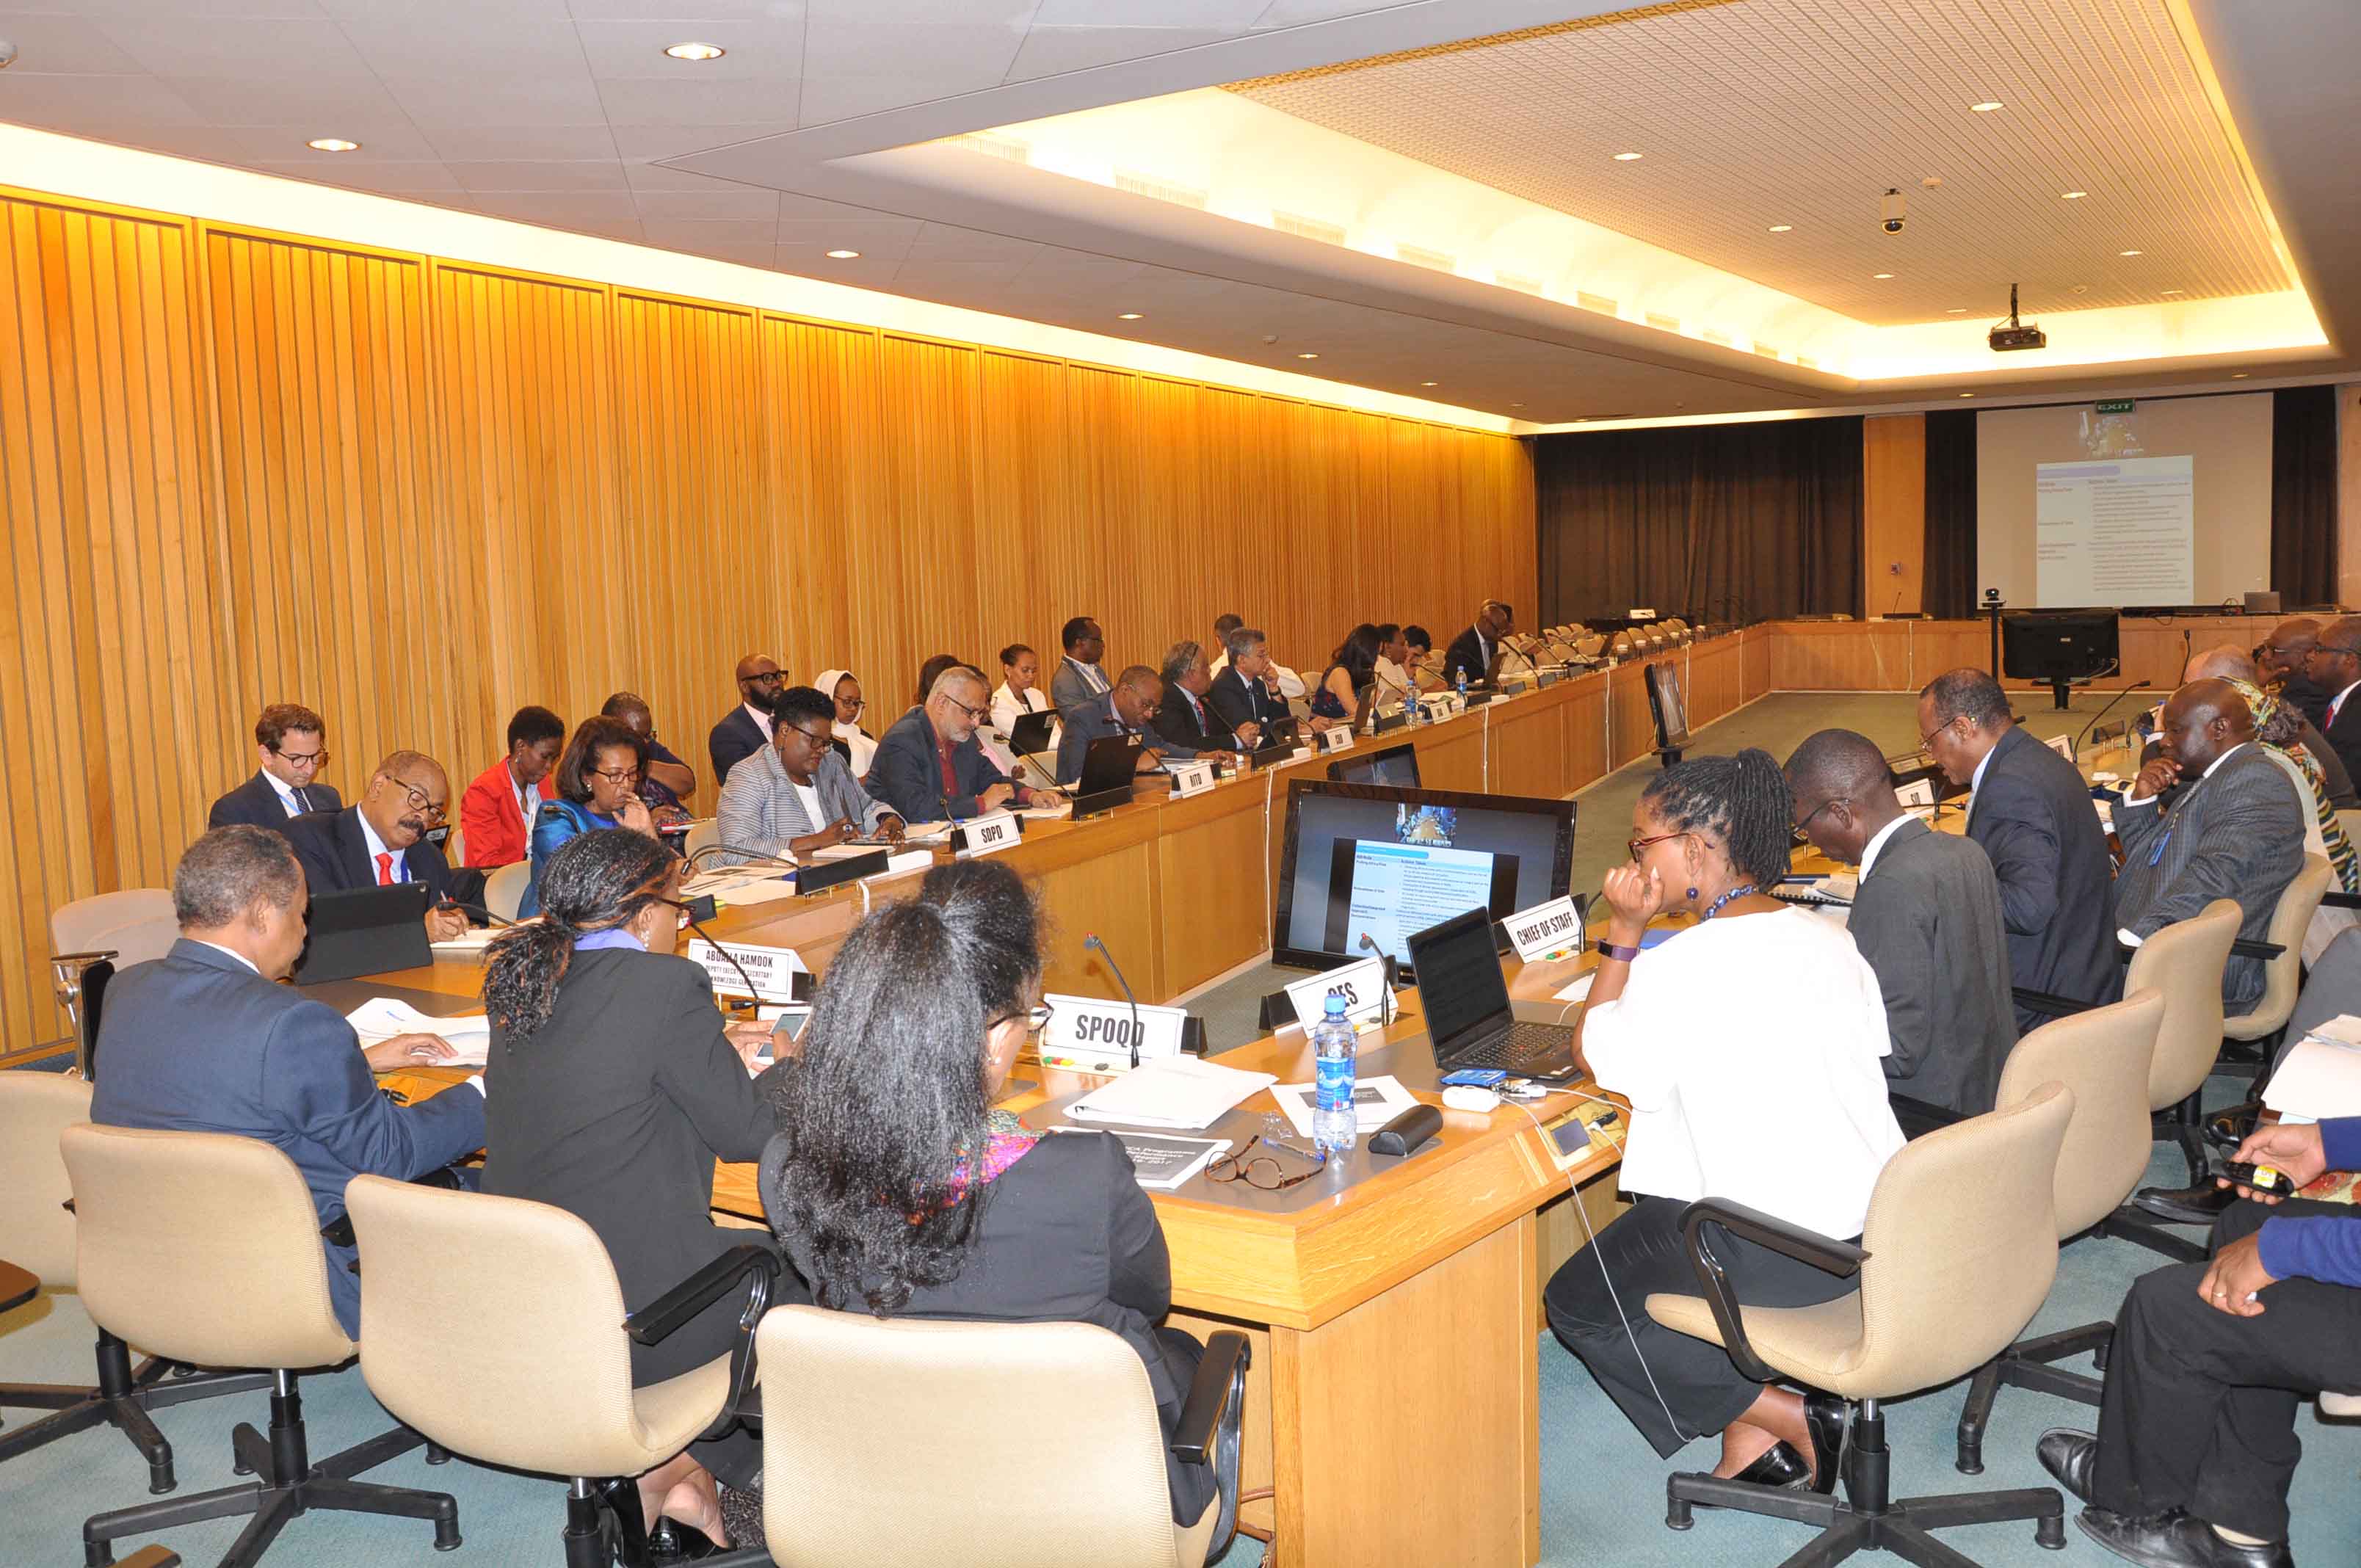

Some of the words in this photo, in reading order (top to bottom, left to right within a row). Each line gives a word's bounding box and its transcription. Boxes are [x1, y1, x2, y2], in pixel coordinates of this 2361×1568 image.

[2097, 403, 2131, 411] EXIT
[981, 825, 1004, 843] SDPD
[1517, 924, 1541, 945] CHIEF
[1539, 921, 1552, 937] OF
[1550, 912, 1574, 933] STAFF
[740, 954, 773, 968] HAMDOK
[747, 970, 772, 979] SECRETARY
[1076, 1015, 1145, 1048] SPOQD
